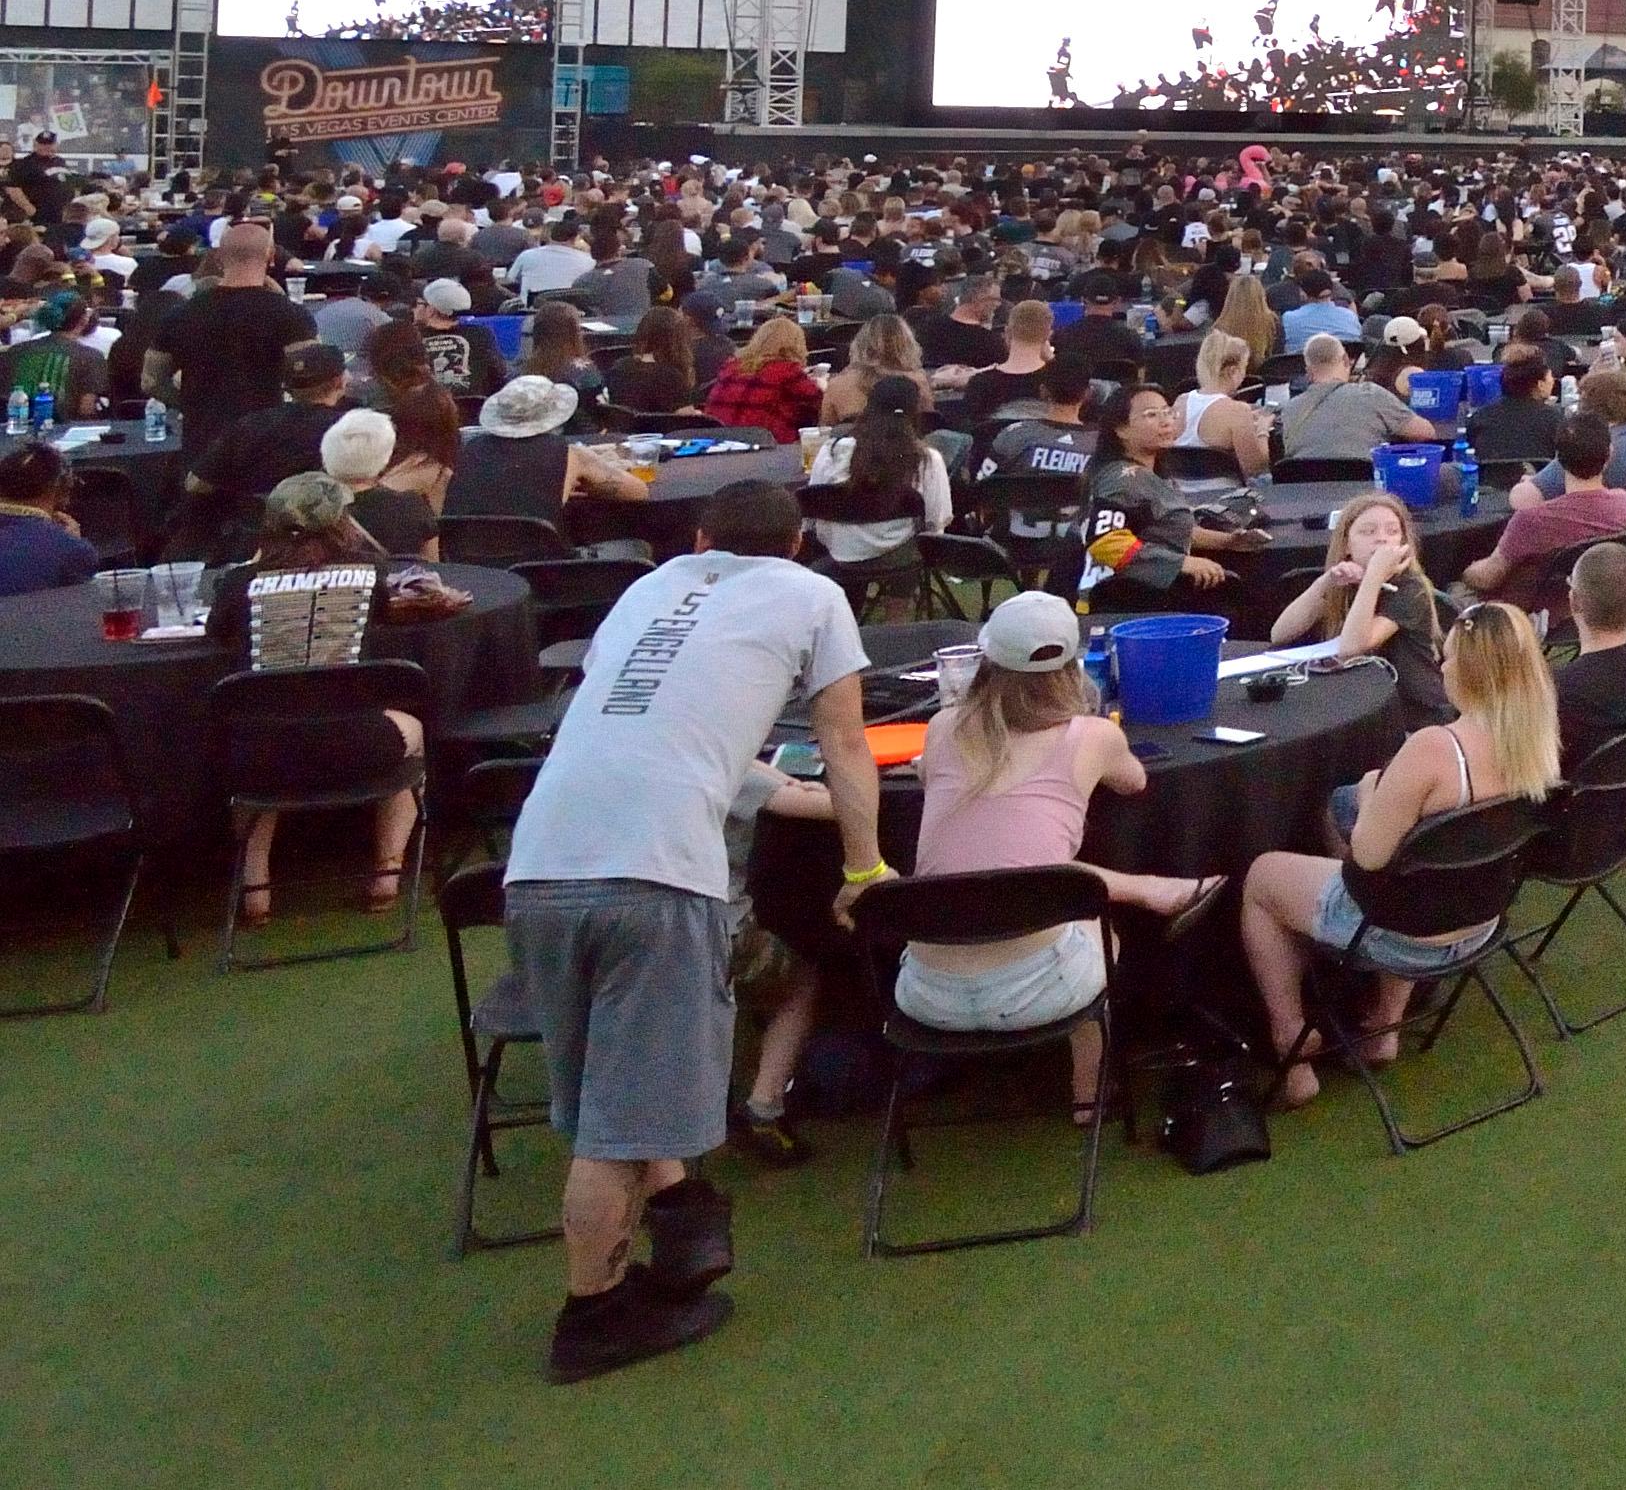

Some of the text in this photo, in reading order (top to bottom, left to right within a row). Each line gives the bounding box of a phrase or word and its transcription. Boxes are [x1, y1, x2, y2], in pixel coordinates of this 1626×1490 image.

[260, 55, 503, 116] Downtown
[307, 118, 362, 135] VEGAS
[367, 111, 430, 130] EVENTS
[435, 105, 498, 123] CENTER
[1031, 447, 1091, 474] FLEURY
[1095, 510, 1125, 536] 29
[247, 569, 377, 597] CHAMPIONS
[602, 618, 699, 715] ENGELLAND
